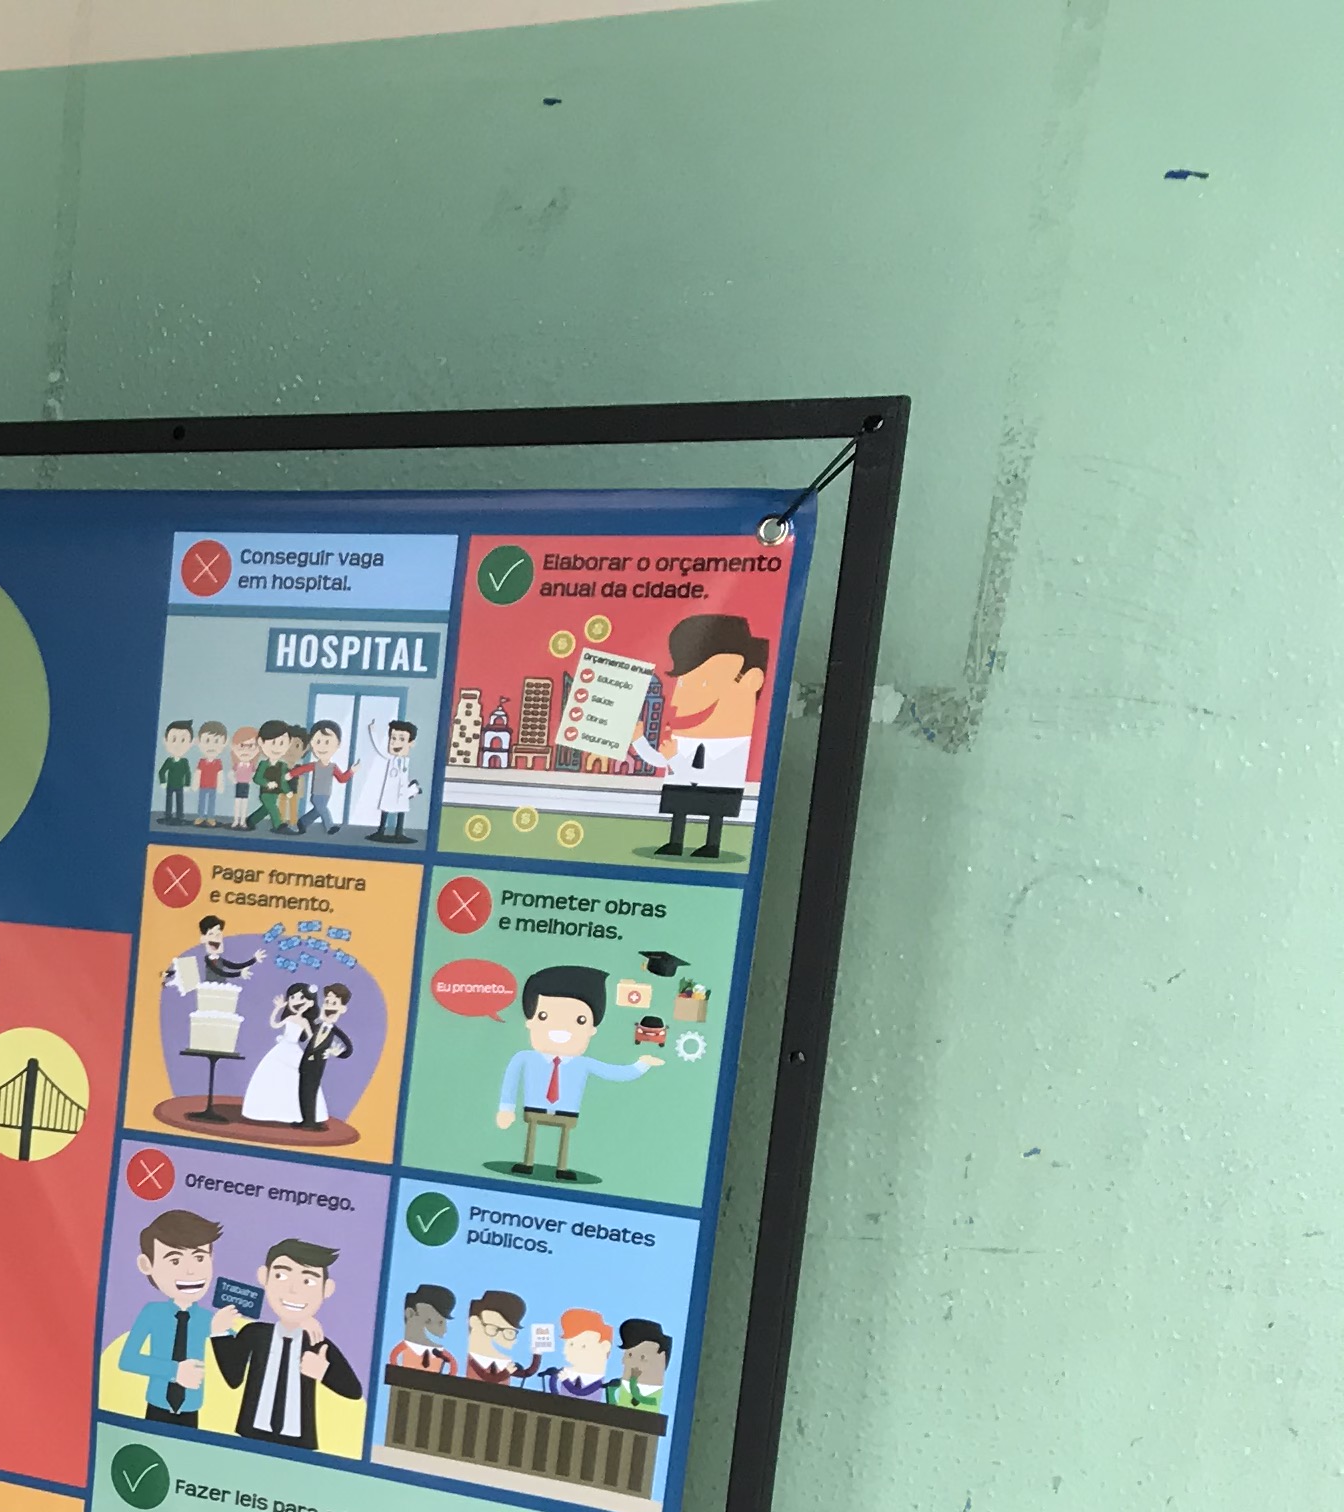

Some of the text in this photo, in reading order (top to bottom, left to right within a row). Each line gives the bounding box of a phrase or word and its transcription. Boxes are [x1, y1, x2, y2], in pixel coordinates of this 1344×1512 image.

[240, 547, 384, 571] Conseguir vaga
[542, 553, 782, 577] Elaborar o orçamento
[238, 572, 352, 593] em hospital.
[539, 578, 709, 600] anual da cidade.
[276, 633, 428, 673] HOSPITAL
[583, 652, 630, 672] Orçamento
[597, 675, 634, 691] Educação
[591, 694, 615, 707] Saúde
[586, 713, 608, 726] Obras
[581, 731, 620, 750] segurança
[211, 865, 366, 893] Pagar formatura
[209, 891, 334, 914] e casamento.
[500, 890, 668, 920] Prometer obras
[498, 914, 623, 941] e melhorias.
[437, 981, 451, 992] Eu
[185, 1173, 355, 1213] Oferecer emprego.
[469, 1206, 656, 1248] Promover debates
[466, 1229, 553, 1255] públicos.
[175, 1478, 230, 1503] Fazer
[235, 1490, 268, 1510] leis
